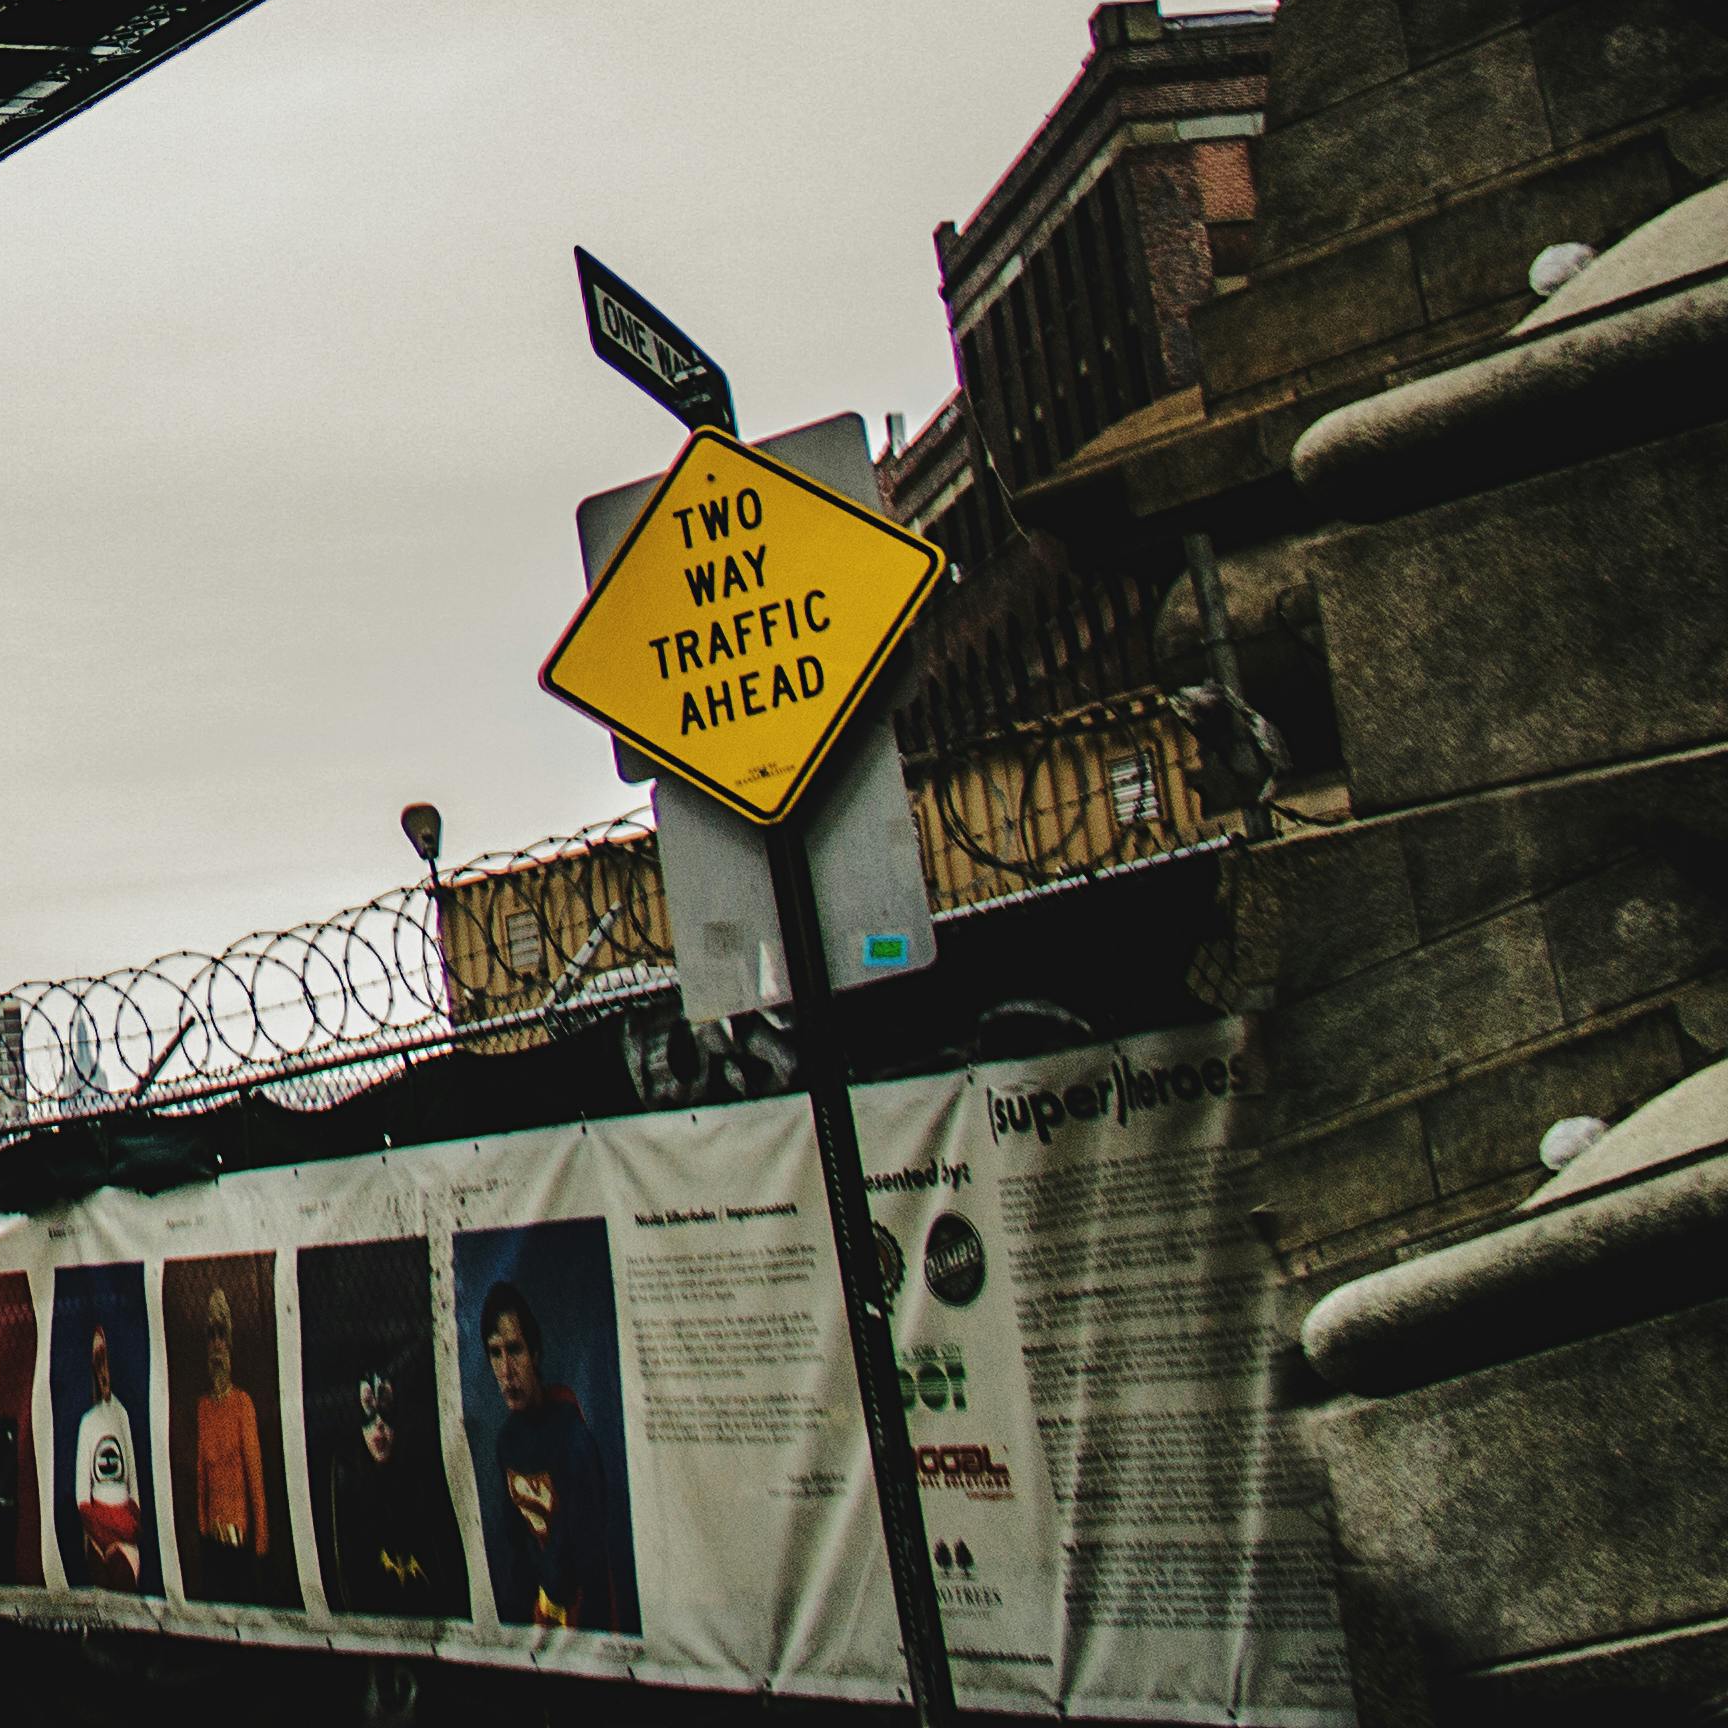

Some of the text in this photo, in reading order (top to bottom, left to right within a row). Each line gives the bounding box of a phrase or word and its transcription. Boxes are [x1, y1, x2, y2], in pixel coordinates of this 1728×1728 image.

[602, 296, 694, 380] ONE WA
[673, 488, 762, 549] TWO
[684, 544, 766, 607] WAY
[649, 589, 830, 679] TRAFFIC
[681, 655, 824, 736] AHEAD
